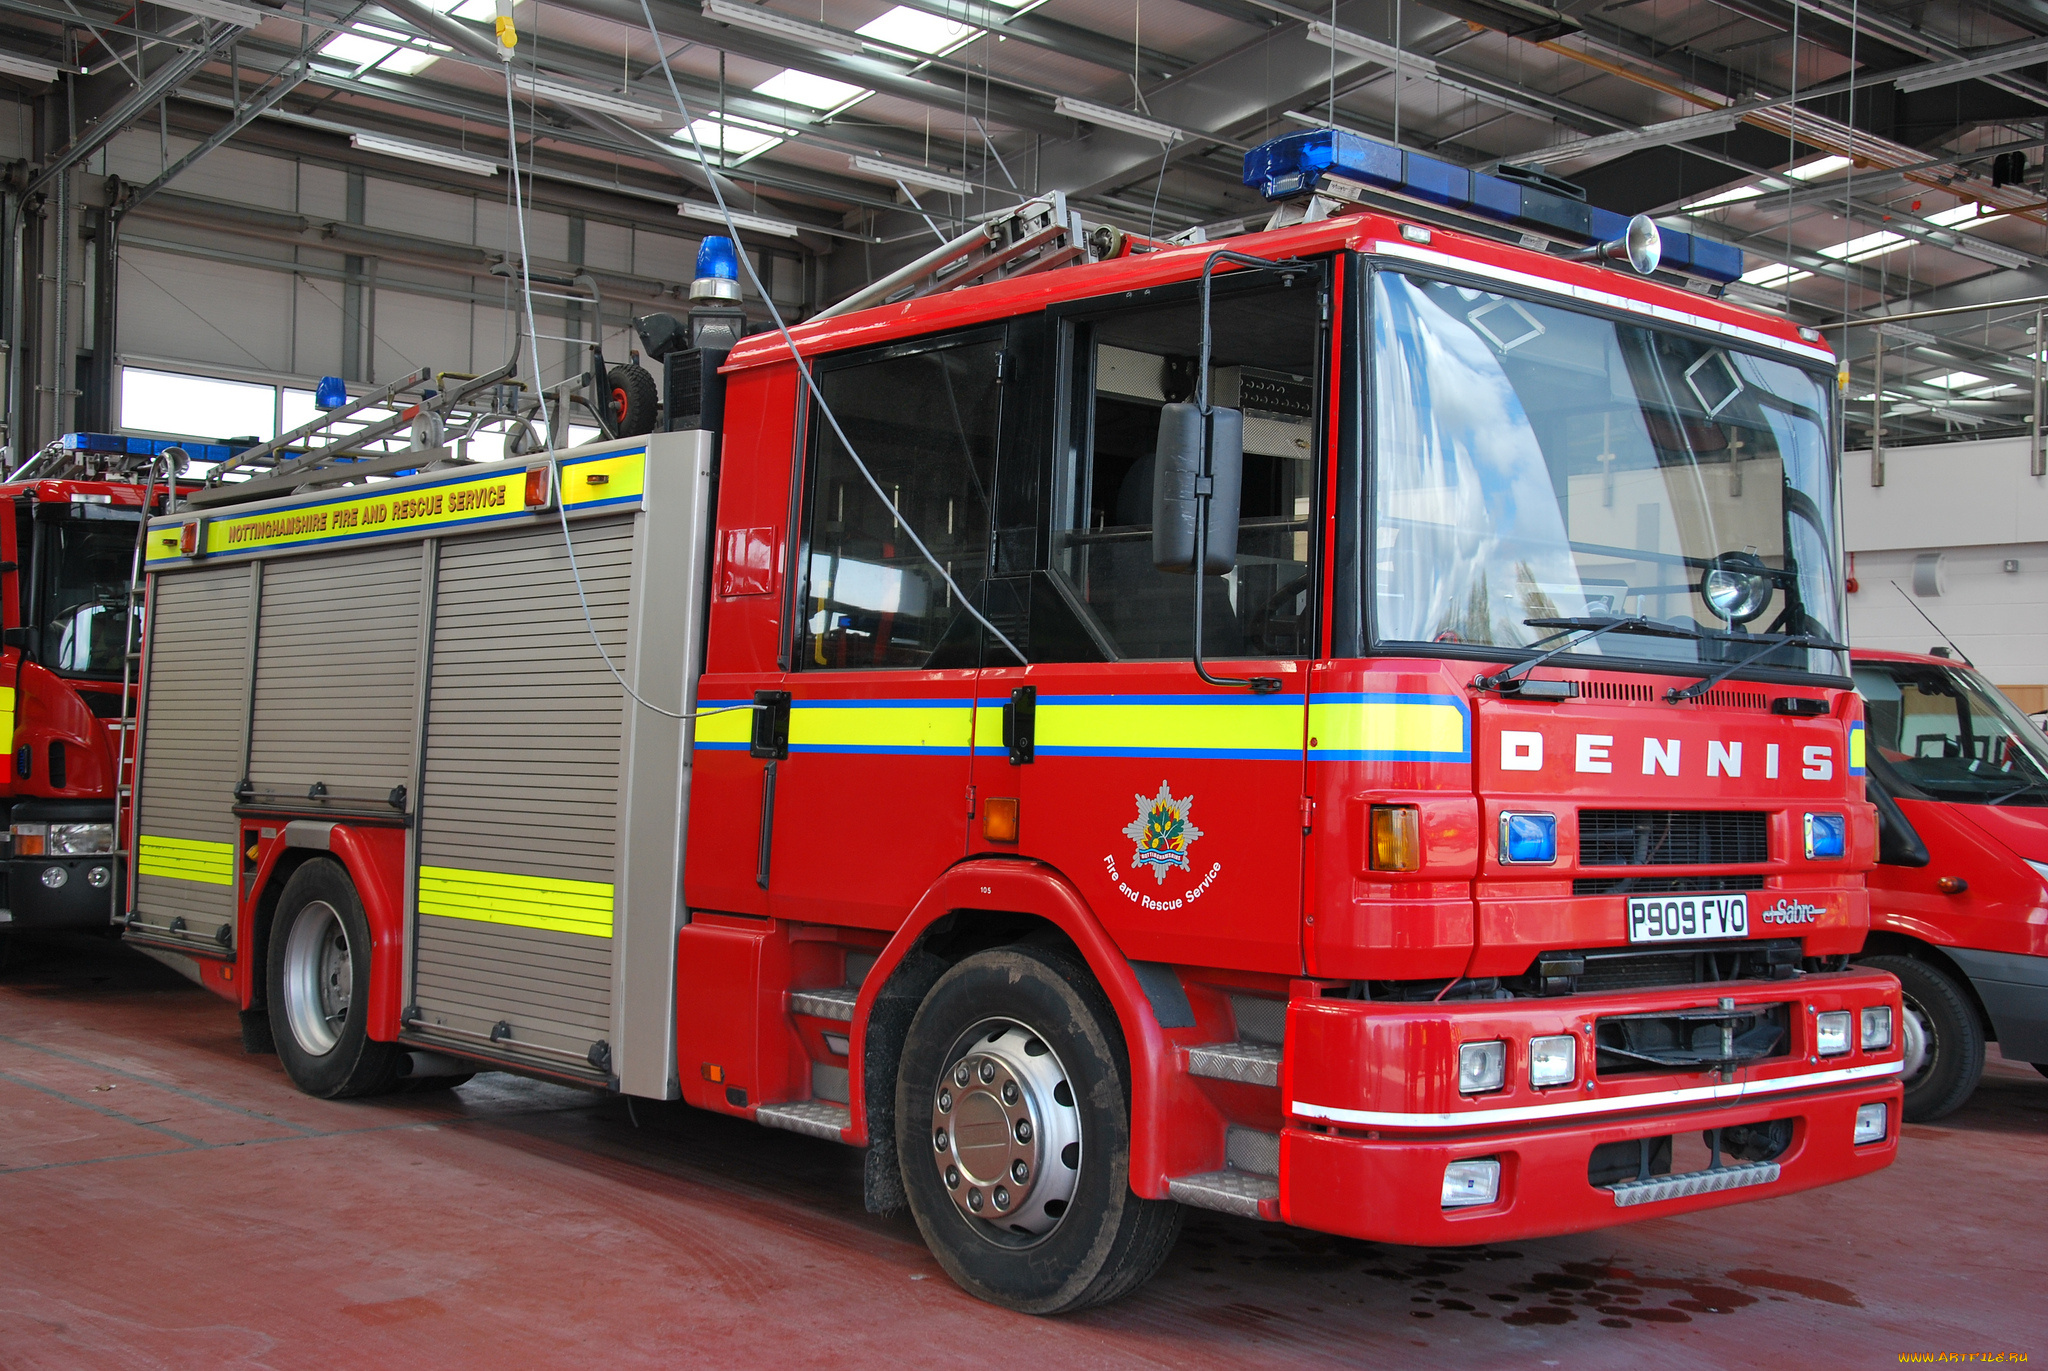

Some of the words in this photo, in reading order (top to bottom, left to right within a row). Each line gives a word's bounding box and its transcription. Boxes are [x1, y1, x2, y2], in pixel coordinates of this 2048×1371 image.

[228, 512, 327, 544] NOTTINGHAMSHIRE
[332, 508, 359, 530] FIRE
[361, 503, 387, 525] AND
[392, 495, 443, 521] RESCUE
[448, 485, 506, 513] SERVICE
[1500, 730, 1833, 781] DENNIS
[980, 886, 992, 894] 105
[1103, 854, 1119, 881] Fire
[1119, 882, 1139, 902] and
[1141, 895, 1183, 911] Rescue
[1185, 862, 1221, 903] Service
[1631, 901, 1696, 938] P909
[1702, 899, 1744, 934] FVO
[1776, 899, 1815, 925] Sabre
